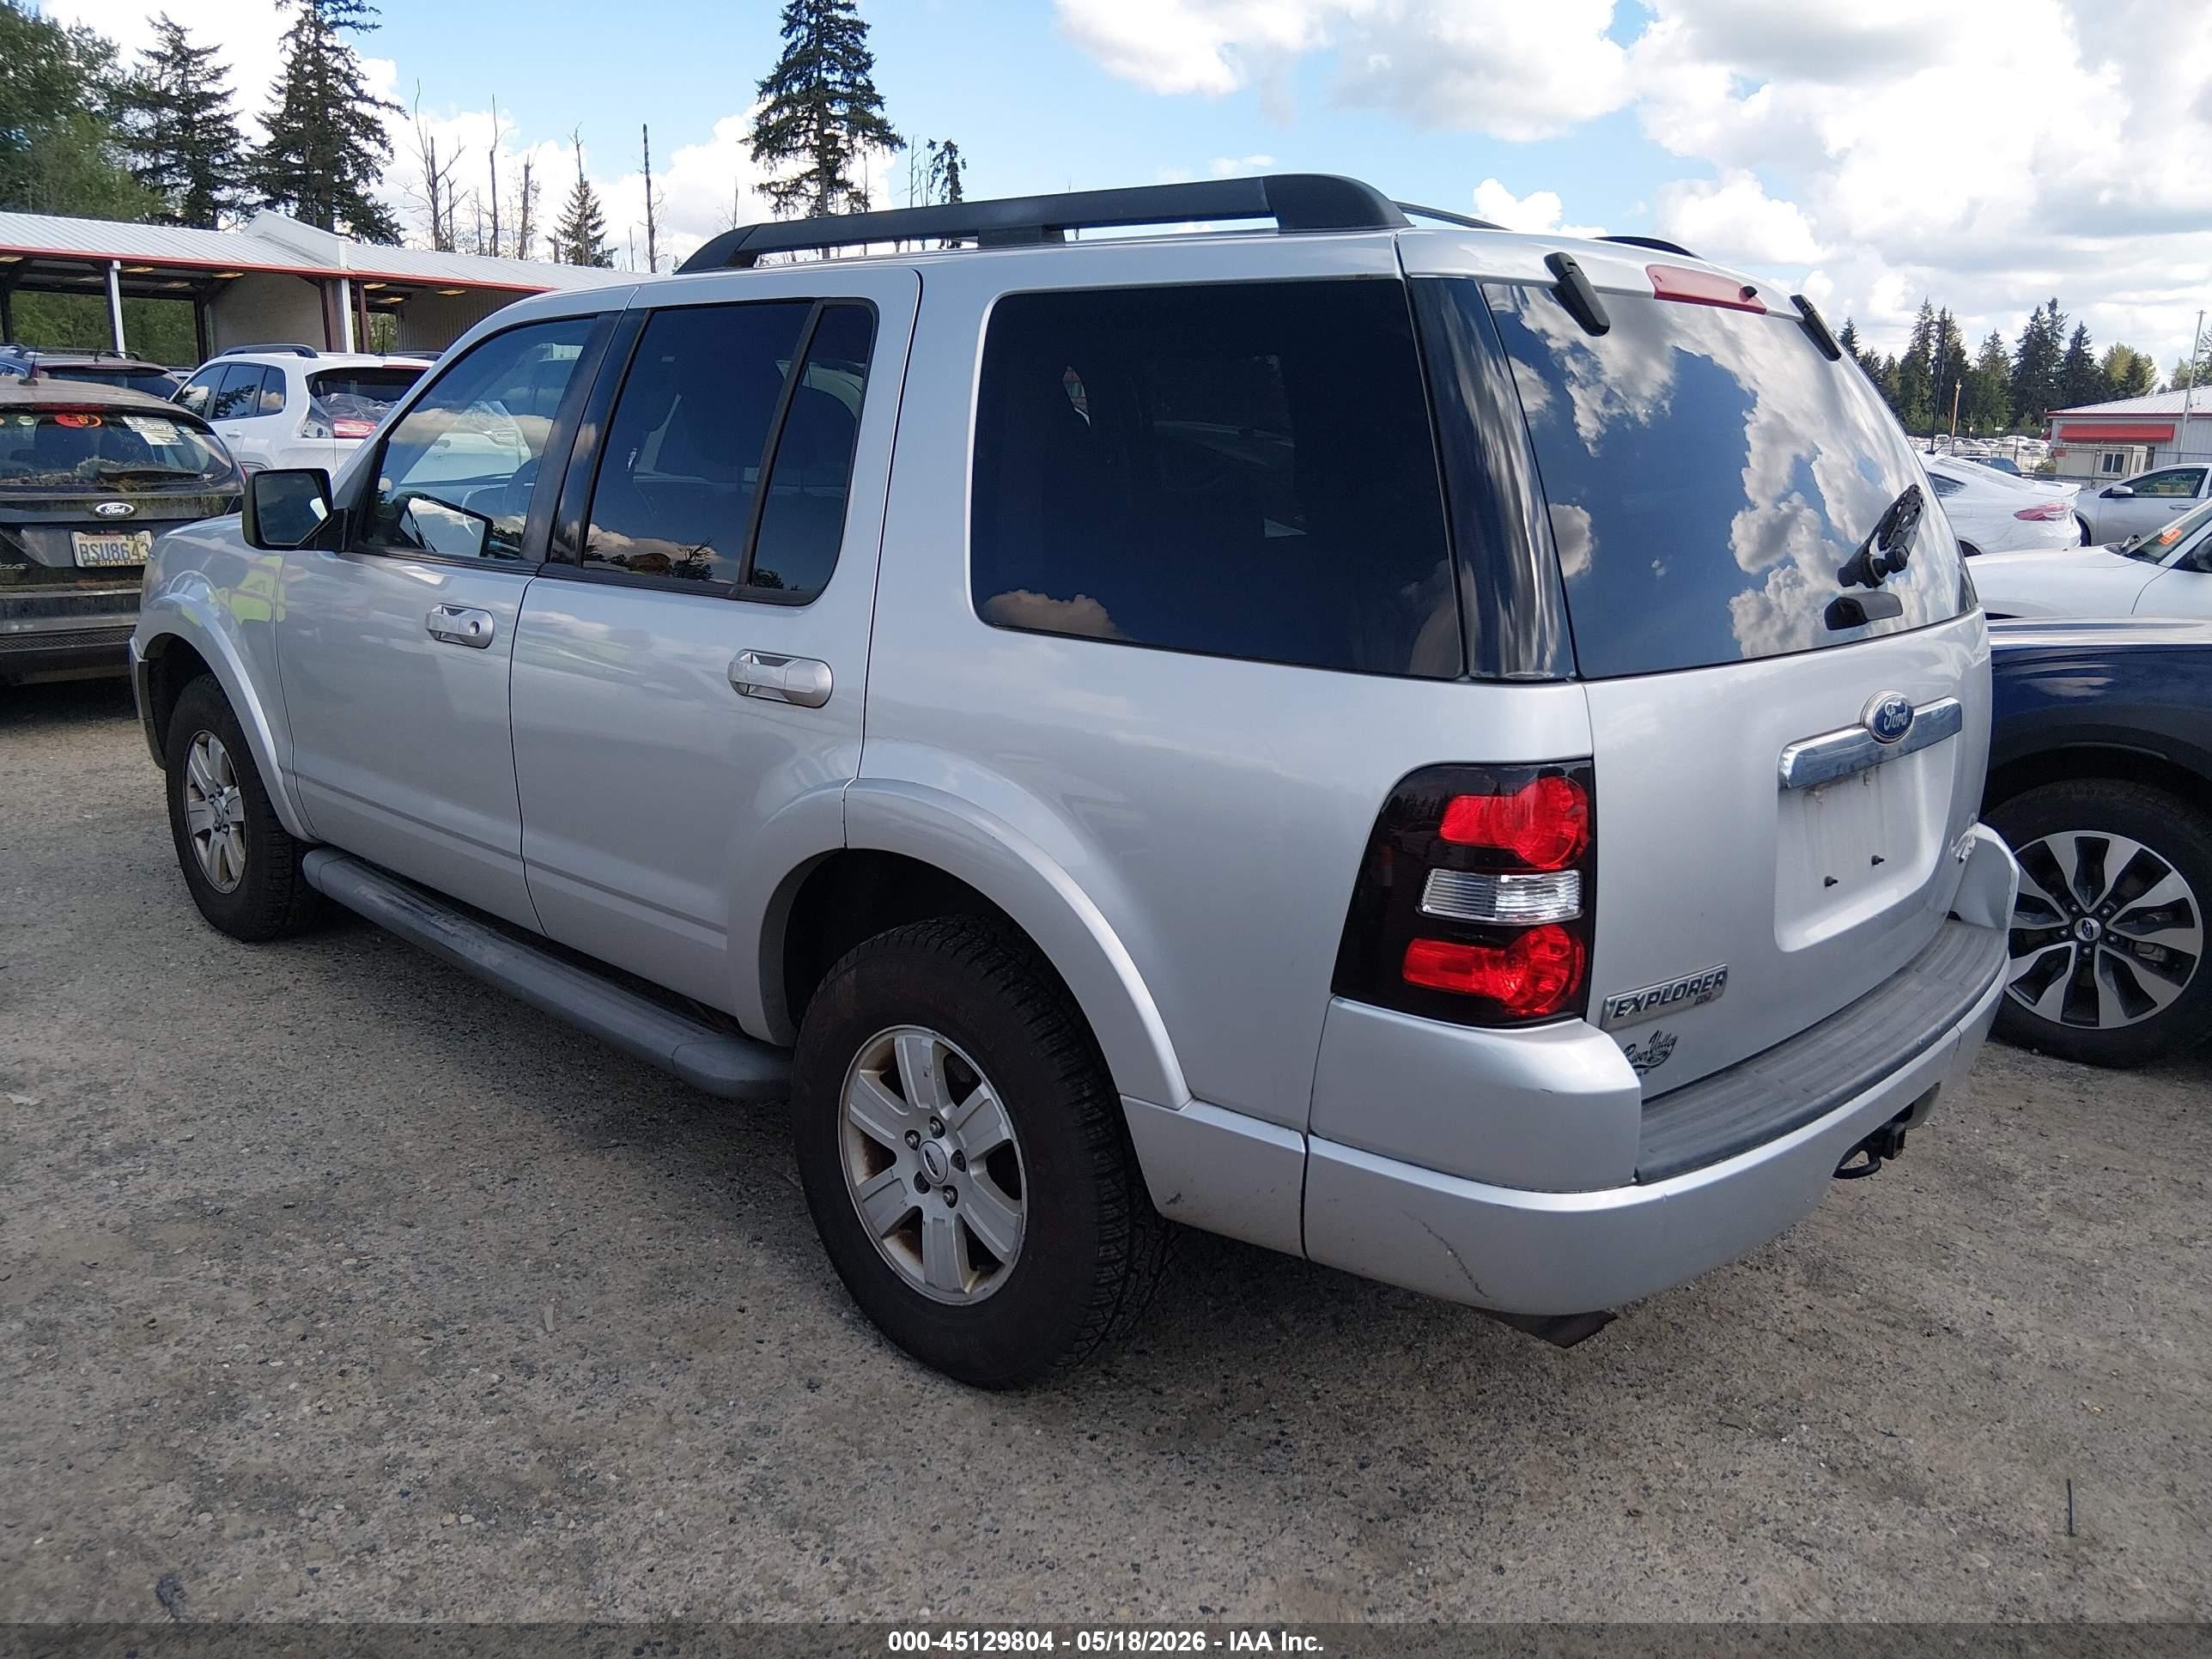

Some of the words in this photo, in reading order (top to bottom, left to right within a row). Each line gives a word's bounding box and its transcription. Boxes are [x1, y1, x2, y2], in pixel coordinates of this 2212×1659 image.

[105, 504, 126, 514] Ford
[78, 542, 150, 563] BSU8643
[1883, 700, 1909, 732] Ford
[1610, 968, 1728, 1019] EXPLORER
